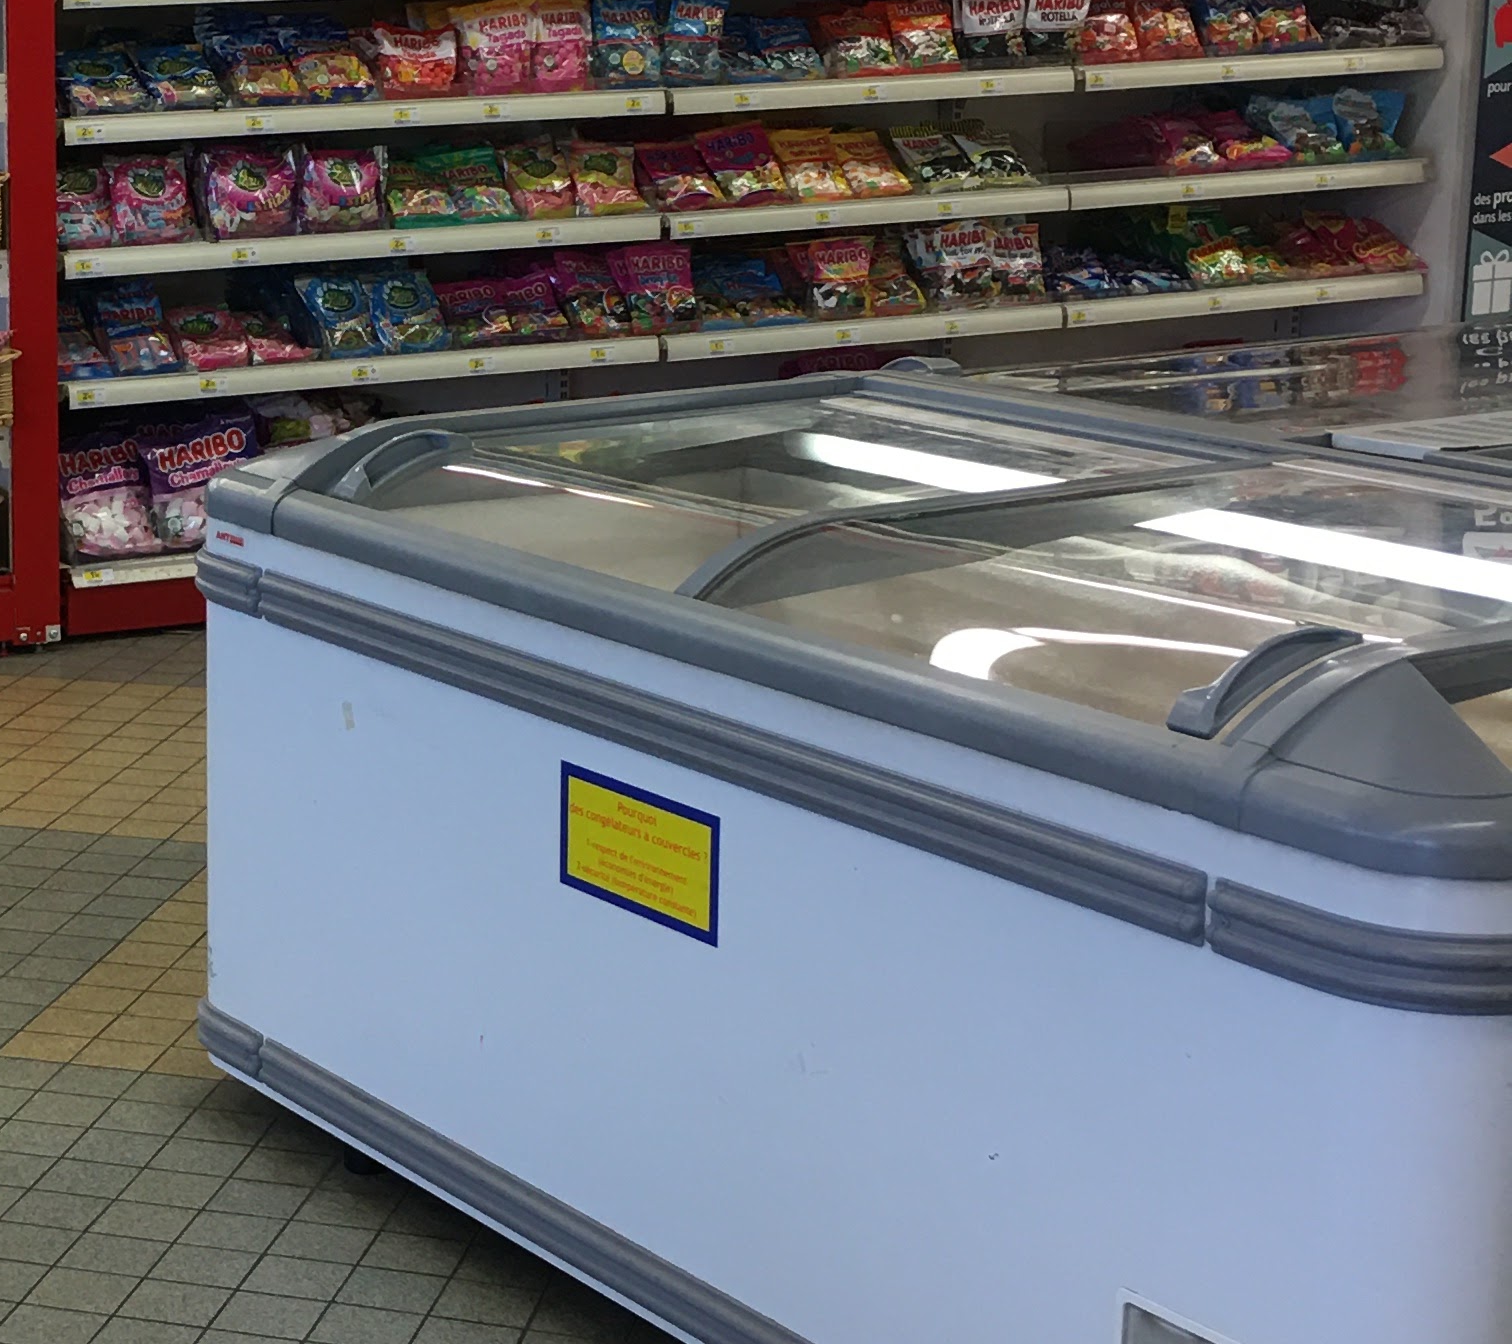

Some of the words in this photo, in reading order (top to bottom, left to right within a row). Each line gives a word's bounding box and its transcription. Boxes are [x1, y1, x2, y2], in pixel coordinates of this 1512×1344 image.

[478, 12, 528, 32] HARIBO
[1040, 11, 1079, 23] ROTELLA
[705, 133, 754, 152] HARIBO
[1473, 192, 1491, 207] des
[1472, 211, 1496, 225] dans
[992, 235, 1034, 250] ARIBO
[630, 256, 686, 272] HARIBO
[815, 246, 870, 266] HARIBO
[60, 439, 138, 476] HARIBO
[157, 426, 247, 473] HARIBO
[617, 801, 657, 827] Pourquoi
[569, 802, 584, 817] des
[651, 835, 701, 862] couvercles
